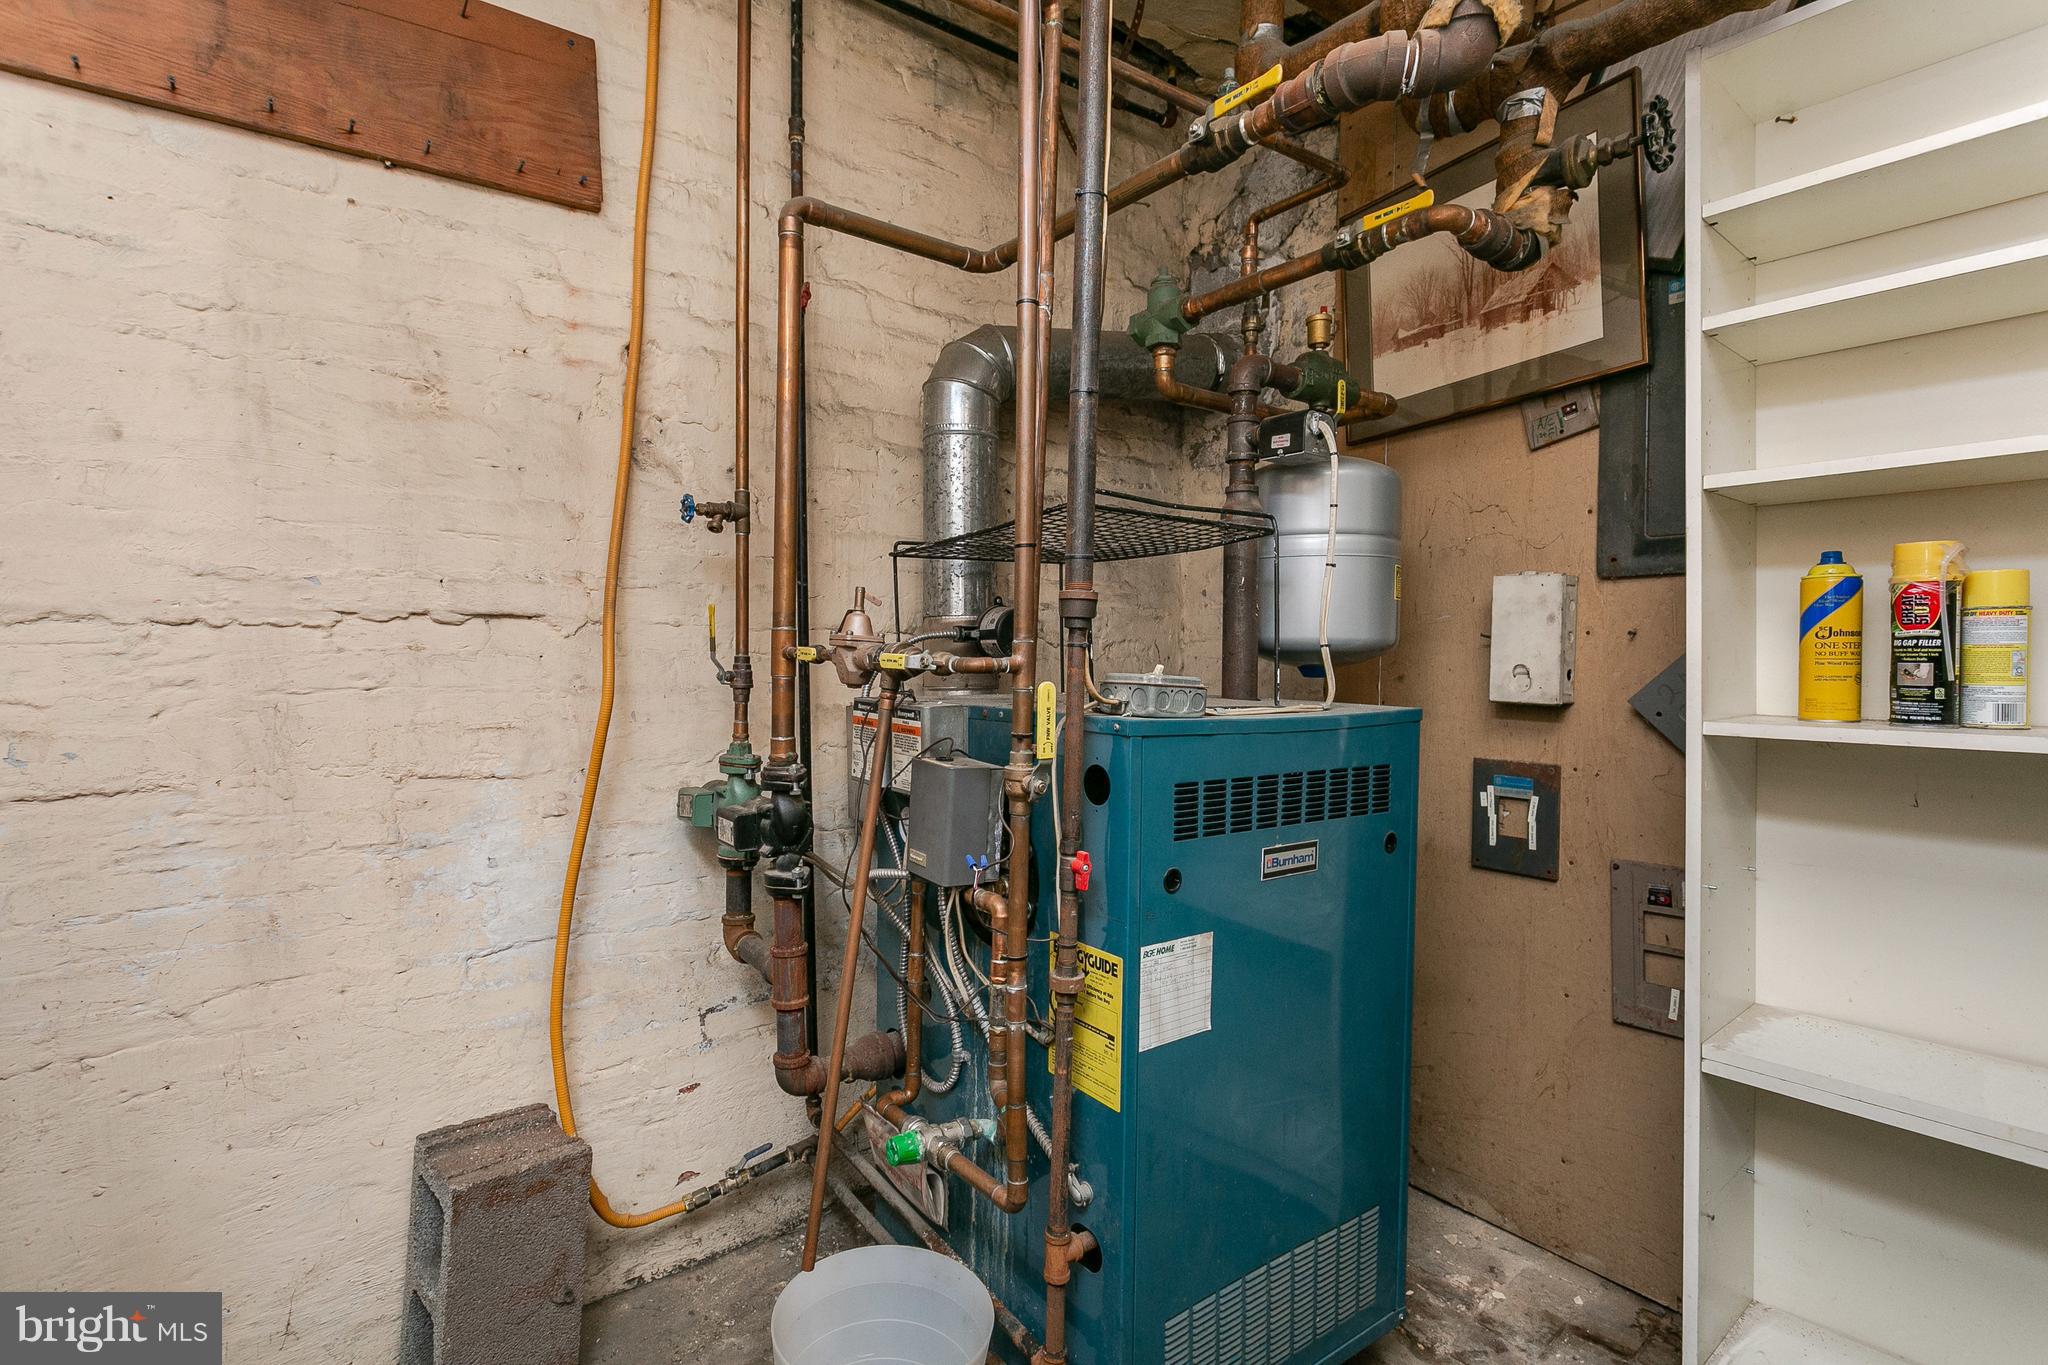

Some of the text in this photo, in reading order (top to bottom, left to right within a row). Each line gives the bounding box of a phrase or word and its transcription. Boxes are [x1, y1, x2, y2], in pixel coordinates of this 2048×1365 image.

[1902, 594, 1915, 624] GREAT
[1915, 594, 1931, 624] STUFF
[1815, 642, 1839, 650] ONE
[1903, 639, 1918, 647] GAP
[1918, 639, 1942, 647] FILLER
[1271, 853, 1314, 868] Burnham
[1156, 944, 1175, 955] HOME
